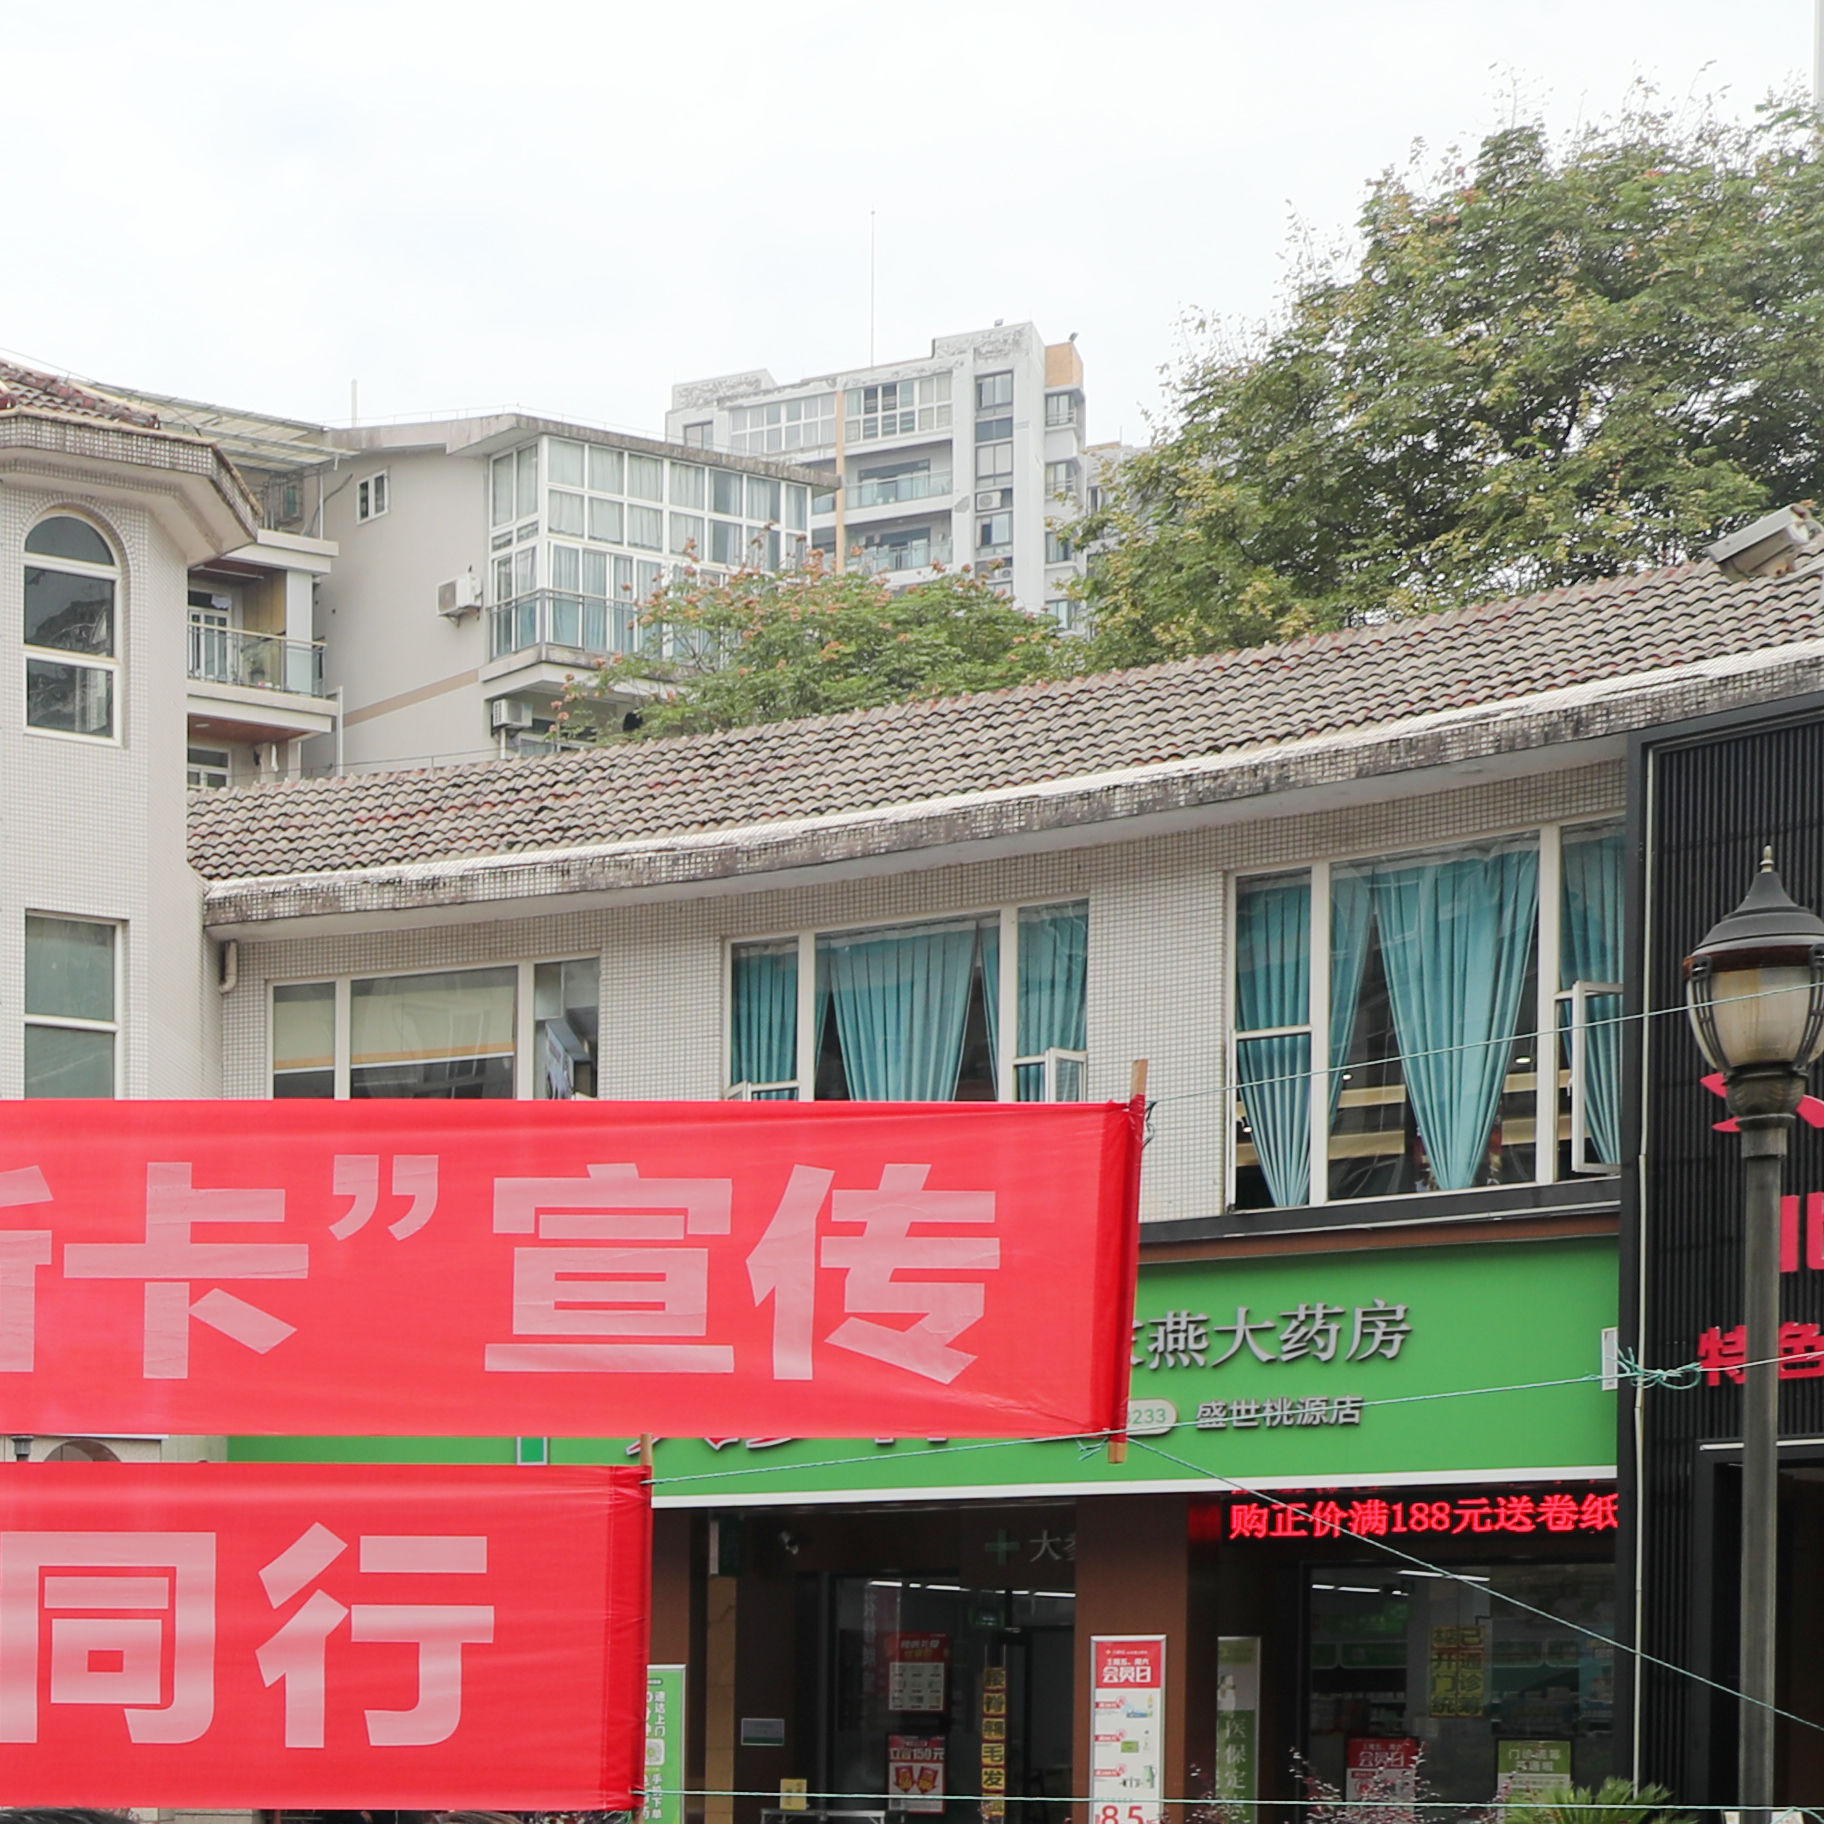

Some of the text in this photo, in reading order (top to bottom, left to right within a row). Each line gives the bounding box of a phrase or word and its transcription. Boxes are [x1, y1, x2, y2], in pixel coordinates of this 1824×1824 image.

[1196, 1395, 1364, 1429] 盛世桃源店
[1228, 1493, 1618, 1540] 购正价满188元送卷纸
[1103, 1666, 1152, 1683] 会员日
